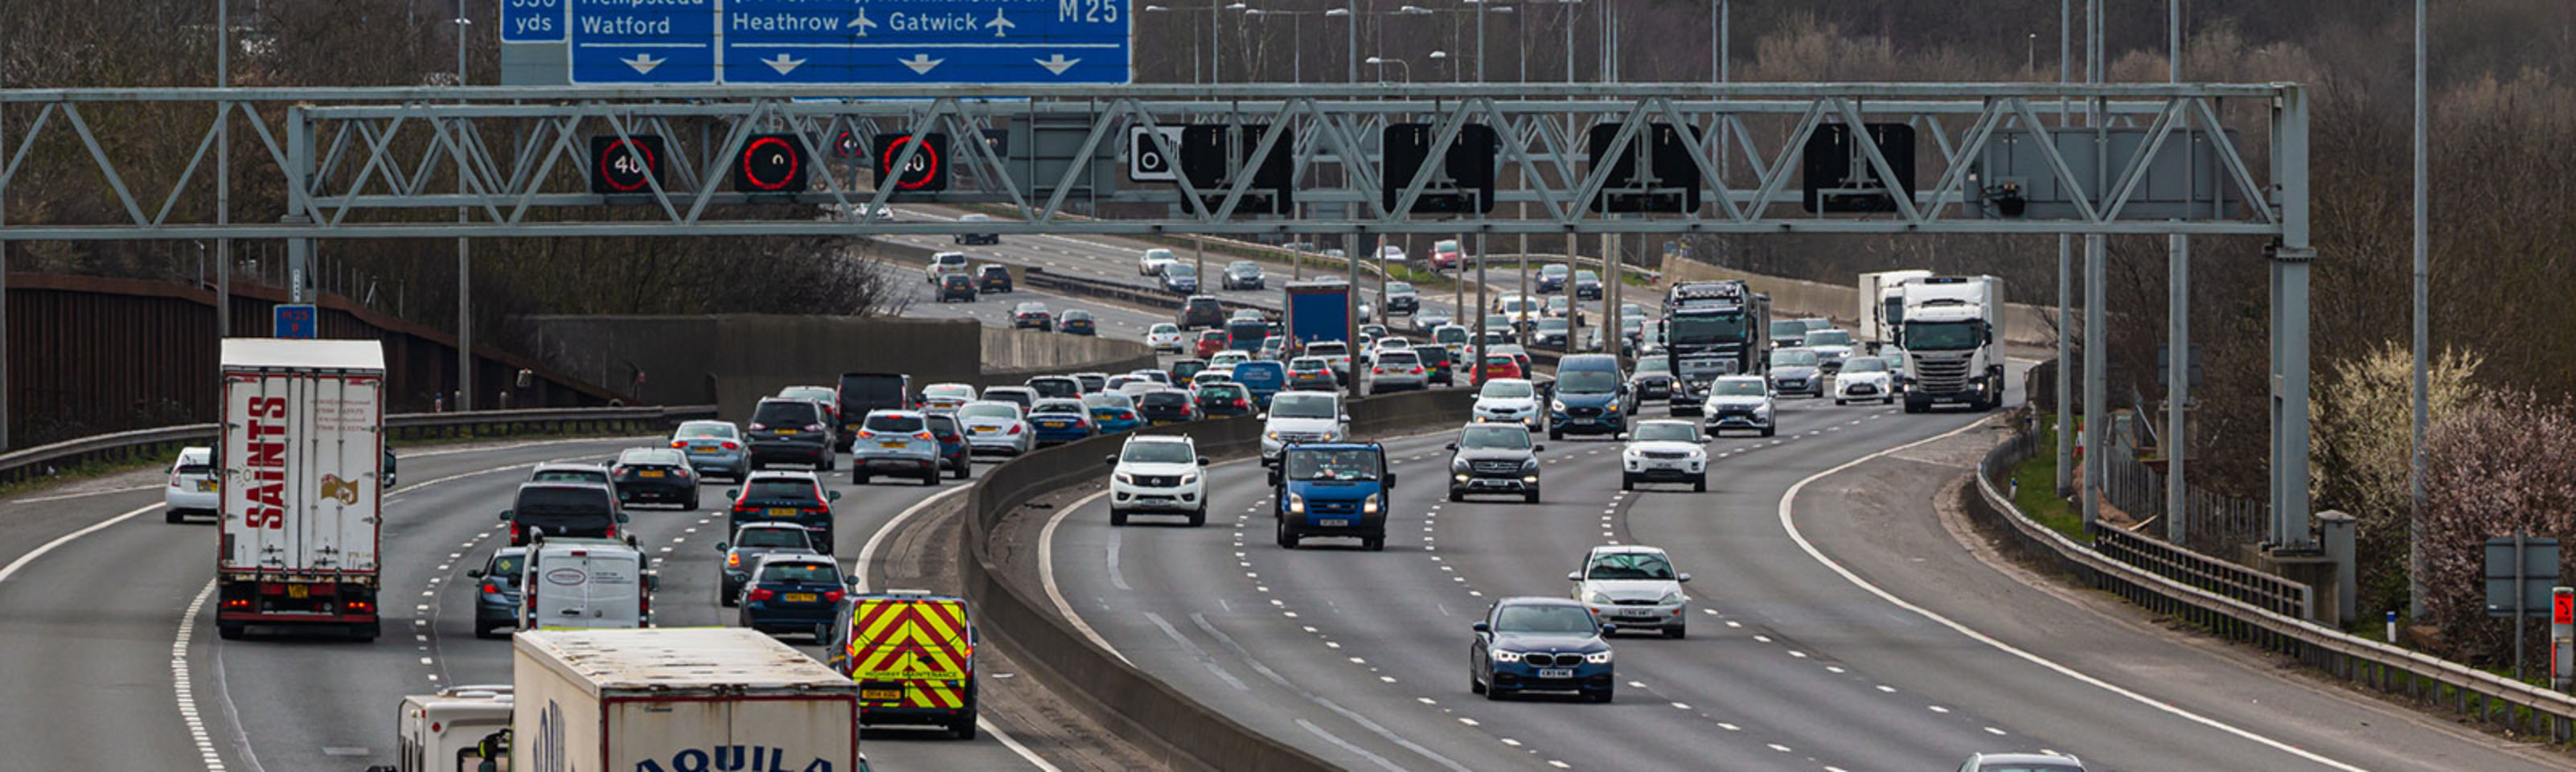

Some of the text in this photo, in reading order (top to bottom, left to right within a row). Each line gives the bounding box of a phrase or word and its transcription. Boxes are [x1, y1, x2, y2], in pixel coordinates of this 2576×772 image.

[515, 14, 552, 35] yds
[581, 16, 670, 35] Watford
[732, 12, 978, 31] Heathrow Gatwick
